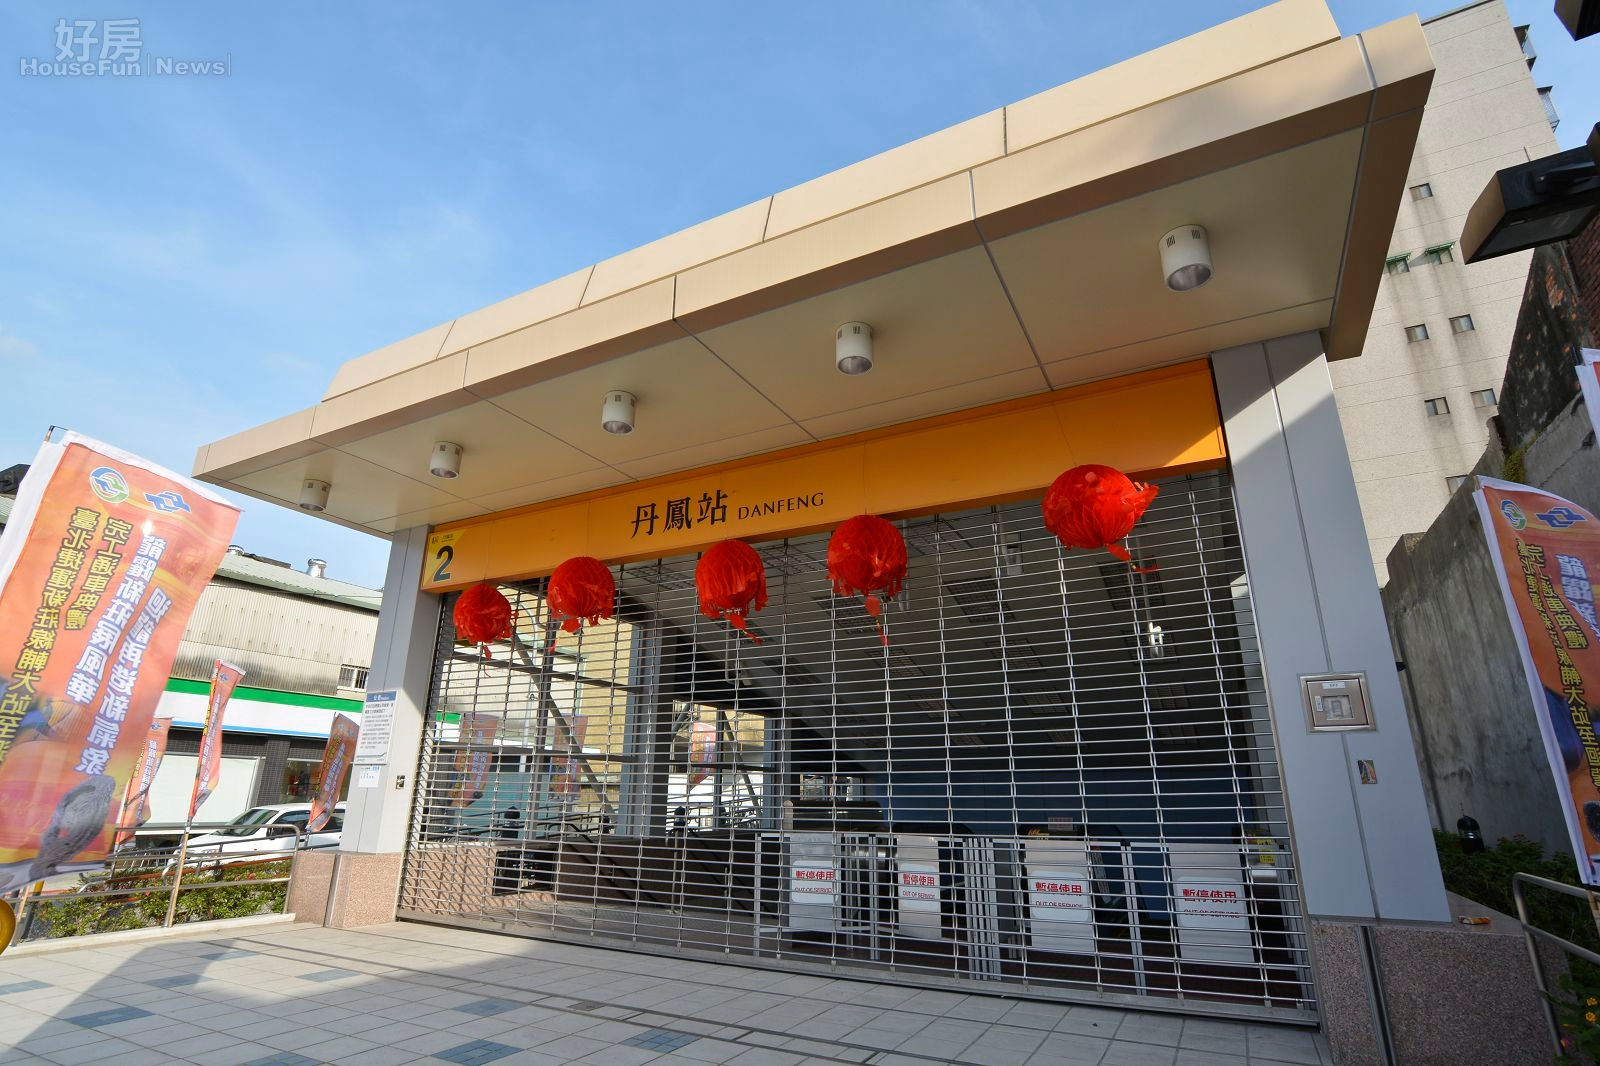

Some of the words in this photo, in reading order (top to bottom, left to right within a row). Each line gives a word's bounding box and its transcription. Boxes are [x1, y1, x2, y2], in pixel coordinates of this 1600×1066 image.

[631, 489, 729, 538] 丹鳳站
[738, 493, 824, 519] DANFENG
[432, 545, 454, 582] 2
[795, 870, 835, 881] 暫停使用
[902, 873, 935, 886] 暫停使用
[1035, 881, 1082, 896] 暫停使用
[1182, 888, 1237, 903] 暫停使用
